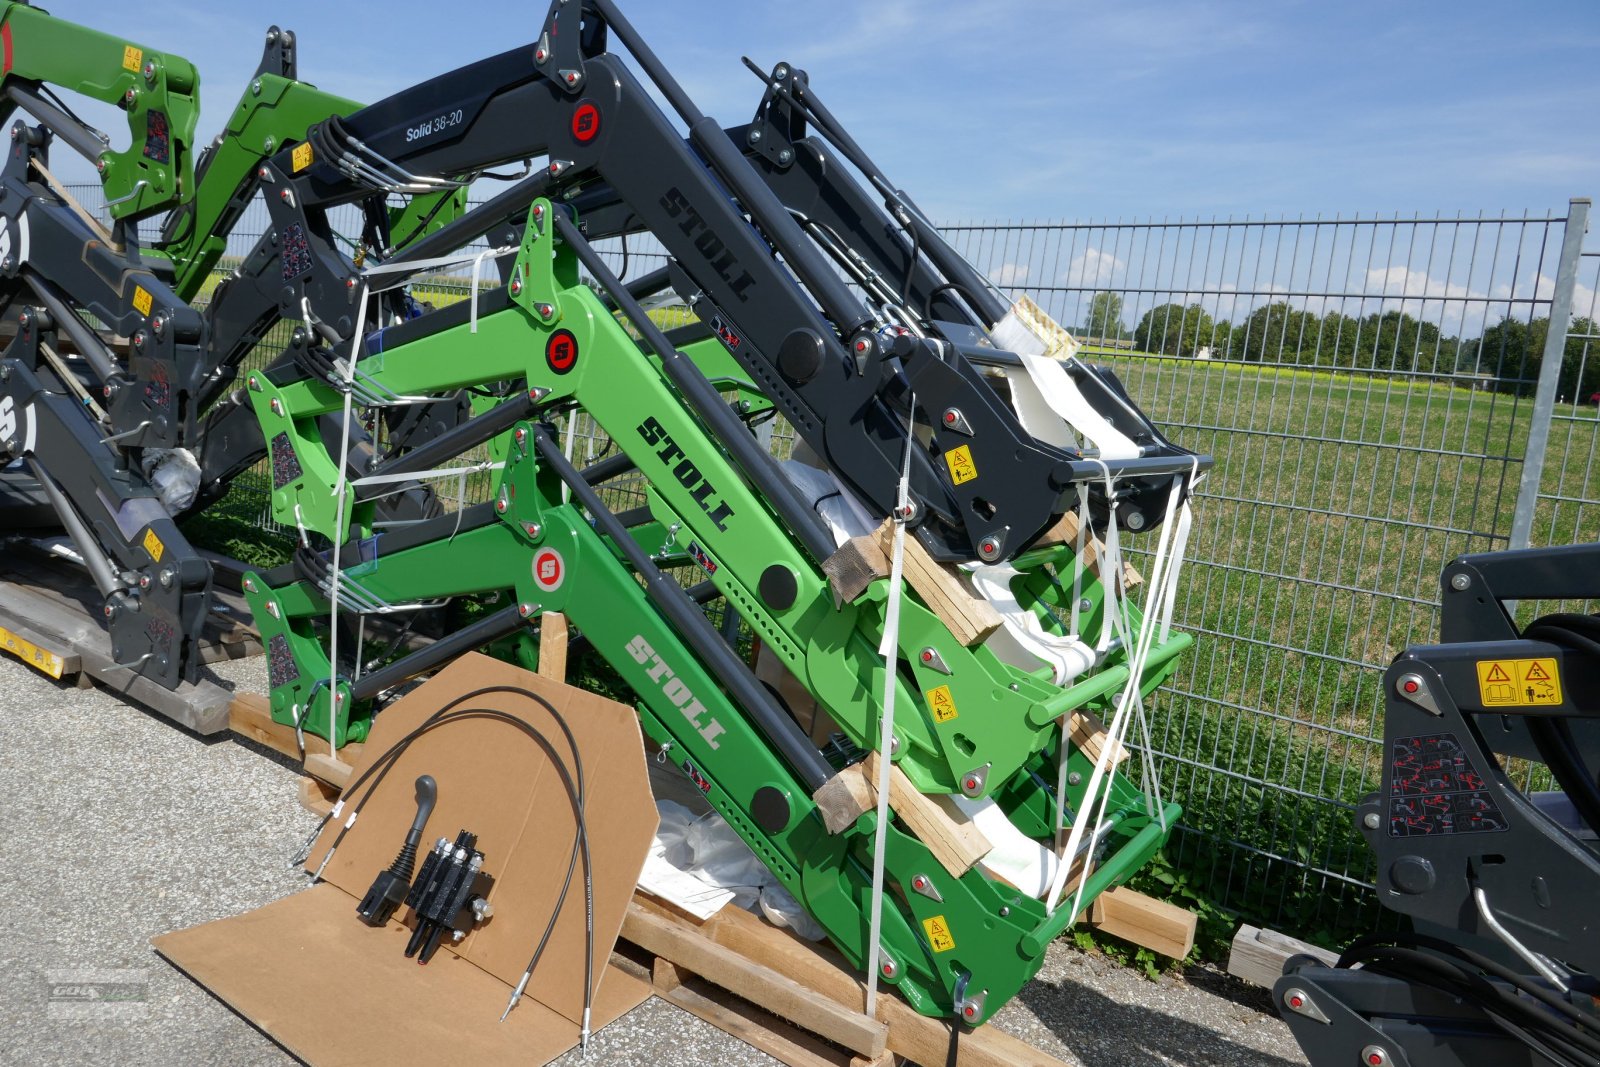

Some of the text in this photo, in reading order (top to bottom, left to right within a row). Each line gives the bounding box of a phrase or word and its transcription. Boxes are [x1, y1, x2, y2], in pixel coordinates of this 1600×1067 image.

[406, 109, 463, 142] Solid 38-20
[659, 187, 757, 303] STOLL
[636, 416, 735, 533] STOLL
[624, 634, 727, 751] STOLL
